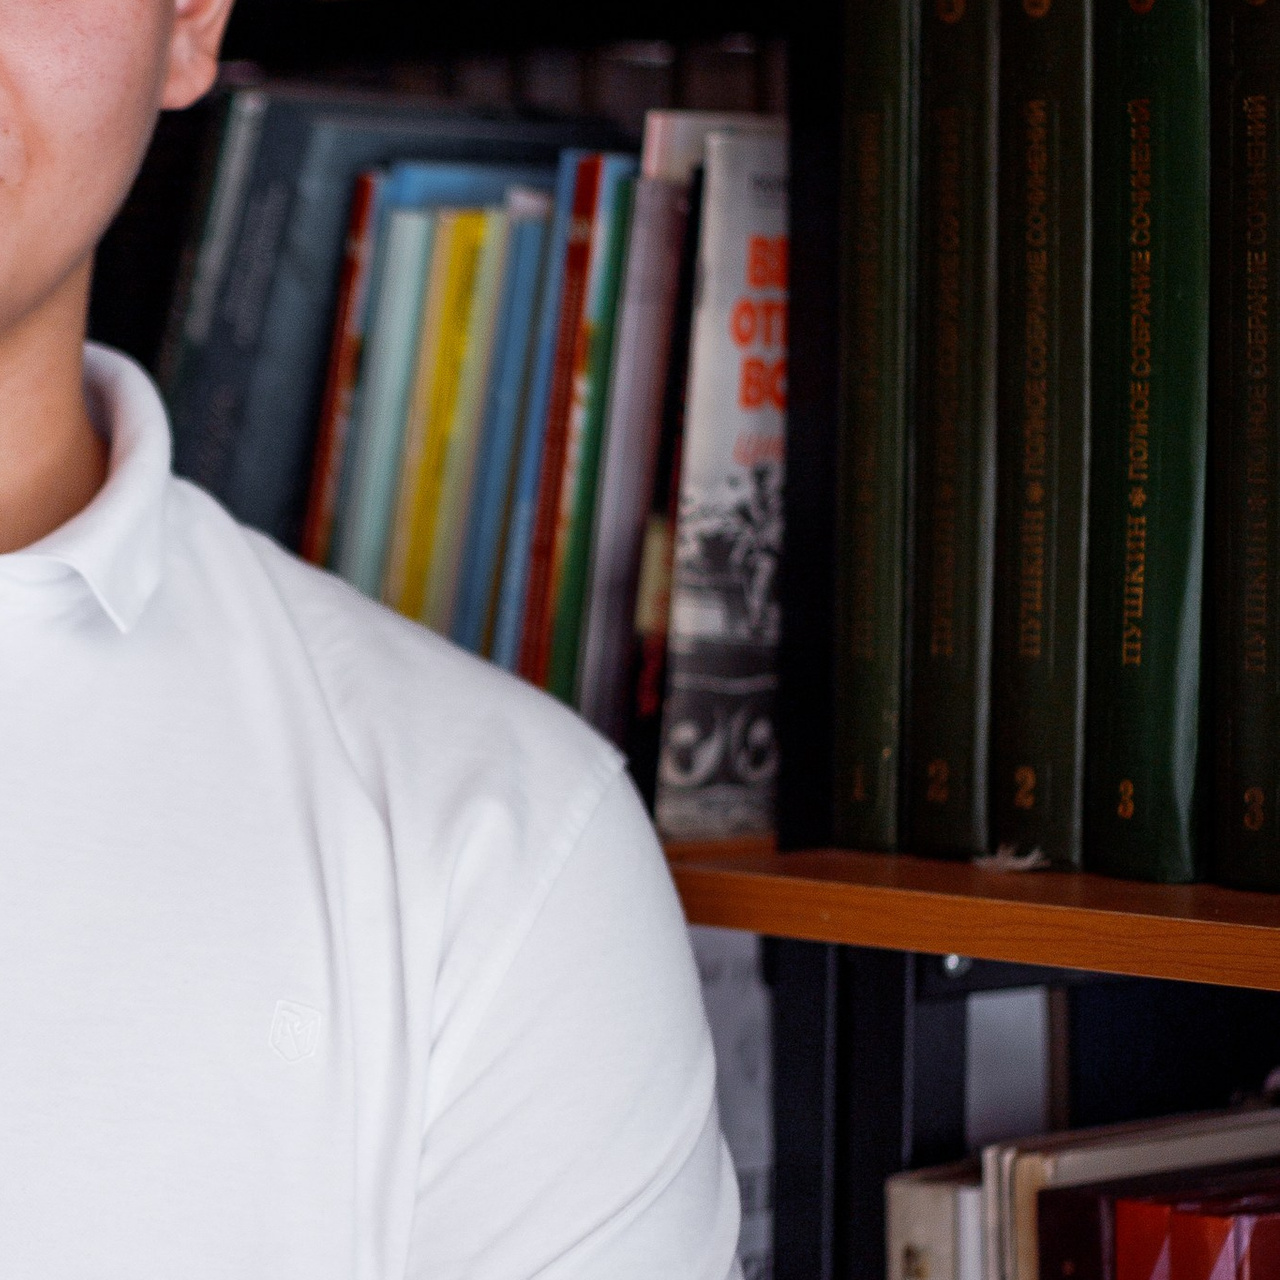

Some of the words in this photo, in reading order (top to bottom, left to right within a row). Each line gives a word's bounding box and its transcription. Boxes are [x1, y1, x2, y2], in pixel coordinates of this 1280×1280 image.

[1024, 100, 1048, 246] СОЧИНЕНИЙ
[1128, 97, 1152, 245] СОЧИНЕНИЙ
[1243, 94, 1268, 244] СОЧИНЕНИЙ
[1025, 250, 1048, 375] СОБРАНИЕ
[1130, 251, 1151, 377] СОБРАНИЕ
[1246, 251, 1269, 378] СОБРАНИЕ
[1127, 381, 1150, 480] ПОЛНОЕ
[1021, 510, 1045, 657] ПУШКИН
[1123, 515, 1147, 665] ПУШКИН
[1245, 517, 1268, 673] ПУШКИН
[1014, 766, 1036, 809] 2
[1243, 786, 1265, 831] 3
